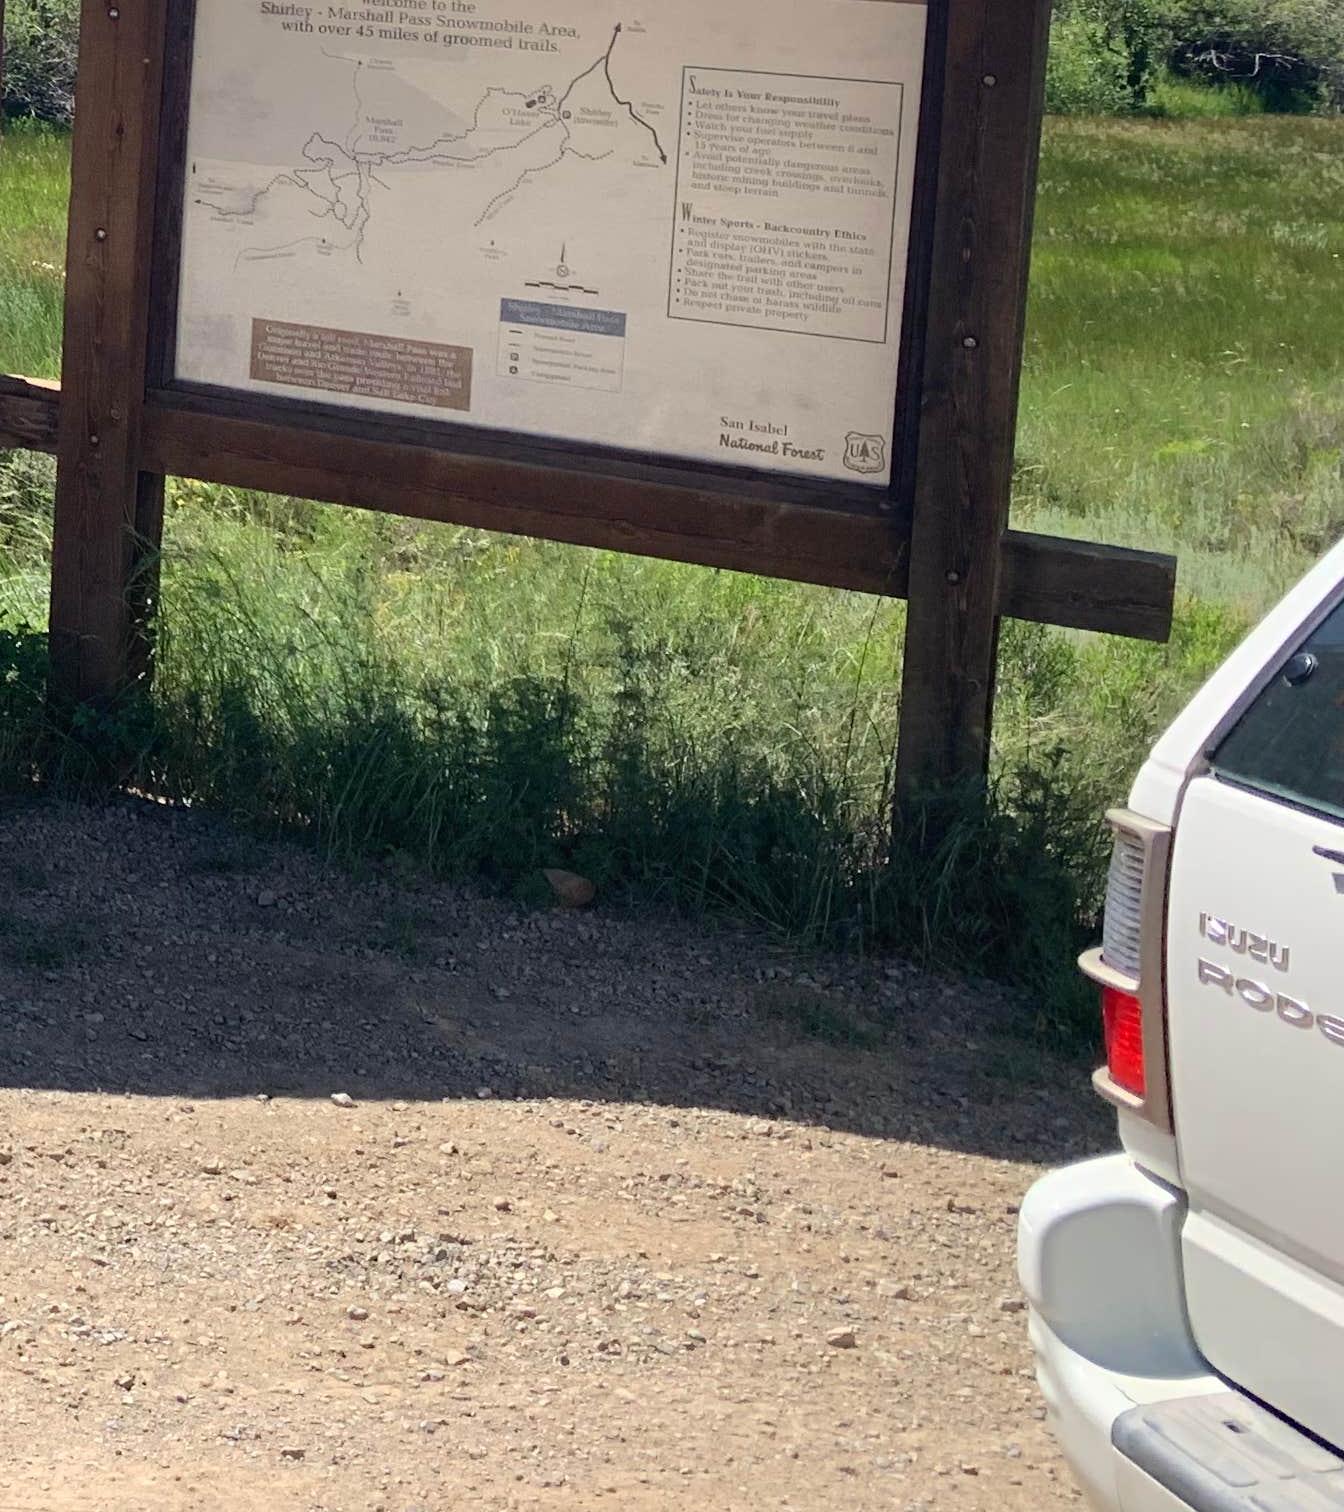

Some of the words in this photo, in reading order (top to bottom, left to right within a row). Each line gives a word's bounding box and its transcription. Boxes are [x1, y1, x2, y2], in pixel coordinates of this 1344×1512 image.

[260, 1, 312, 19] Shirley
[328, 6, 393, 24] Marshall
[399, 11, 431, 26] Pass
[437, 15, 532, 35] Snowmobile
[539, 23, 580, 38] Area,
[432, 0, 446, 12] to
[452, 0, 475, 13] the
[281, 19, 313, 33] with
[318, 24, 352, 36] over
[355, 24, 374, 38] 45
[378, 26, 419, 42] miles
[424, 30, 438, 43] of
[443, 31, 513, 48] groomed
[518, 38, 561, 53] trails.
[689, 75, 721, 98] Safety
[725, 89, 734, 98] Is
[737, 90, 762, 101] Your
[765, 93, 840, 108] Responsibility
[682, 202, 716, 226] Winter
[720, 218, 754, 230] Sports
[765, 222, 830, 238] Backcountry
[834, 228, 866, 241] Ethics
[720, 416, 744, 430] San
[750, 420, 788, 436] Isabel
[720, 434, 779, 455] National
[782, 442, 825, 461] Forest
[1199, 911, 1290, 972] ISUZU
